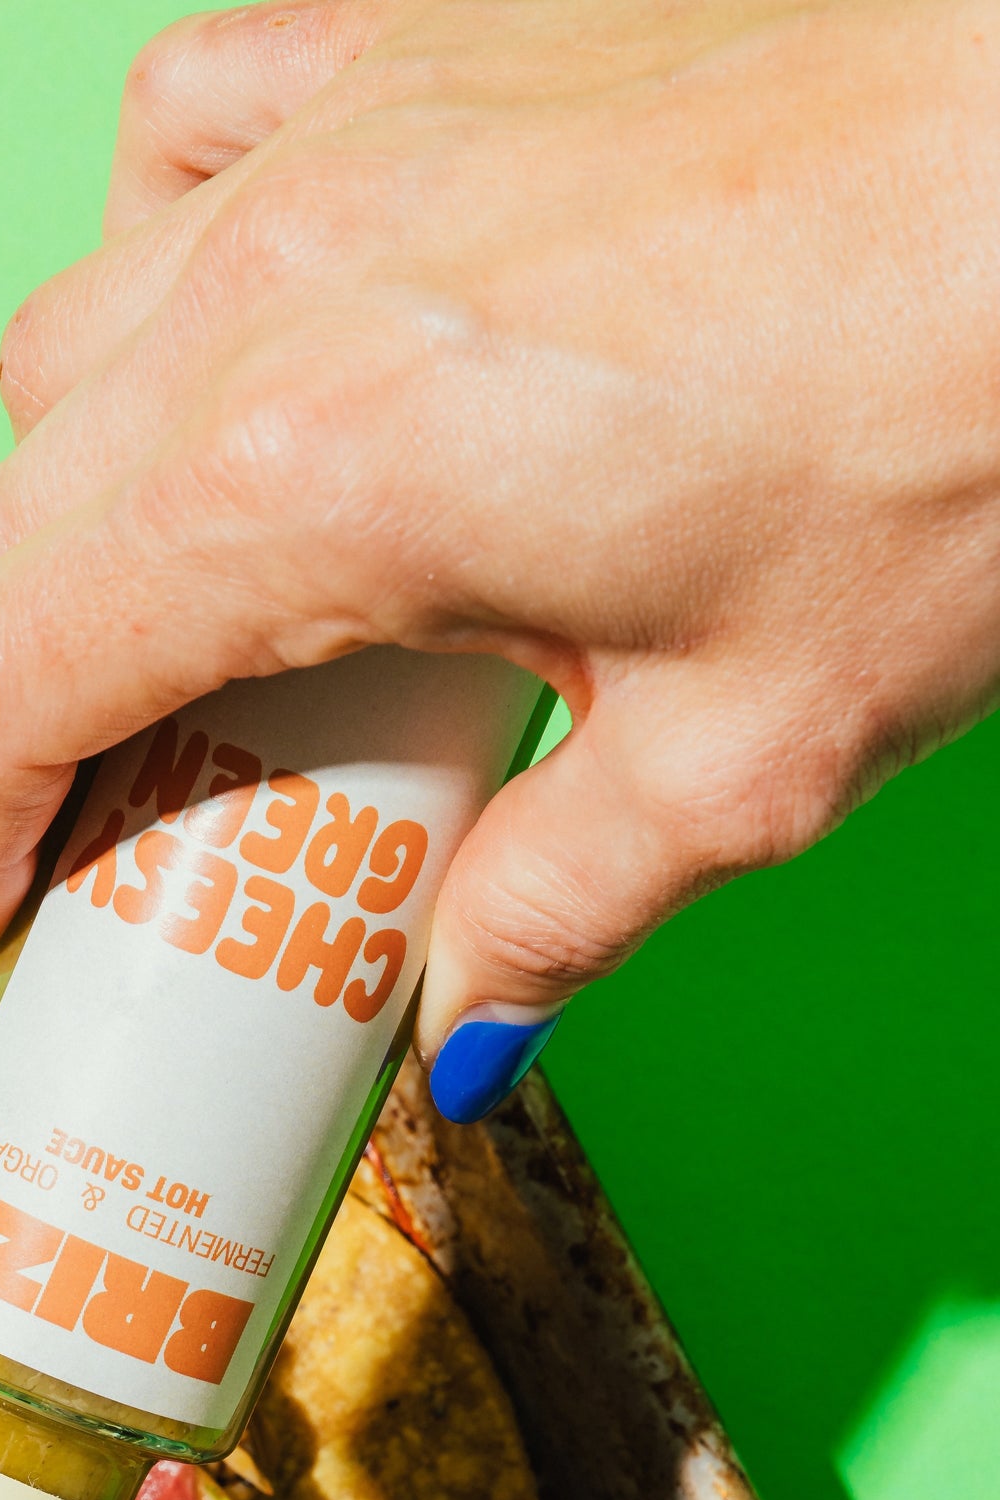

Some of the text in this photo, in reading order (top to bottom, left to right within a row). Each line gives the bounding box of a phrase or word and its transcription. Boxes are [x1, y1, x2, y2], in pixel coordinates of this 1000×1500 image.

[128, 718, 429, 914] GREEN
[67, 808, 408, 1024] CHEESY
[46, 1127, 212, 1219] HOT SAUCE
[81, 1183, 106, 1212] &
[126, 1205, 276, 1278] FERMENTED
